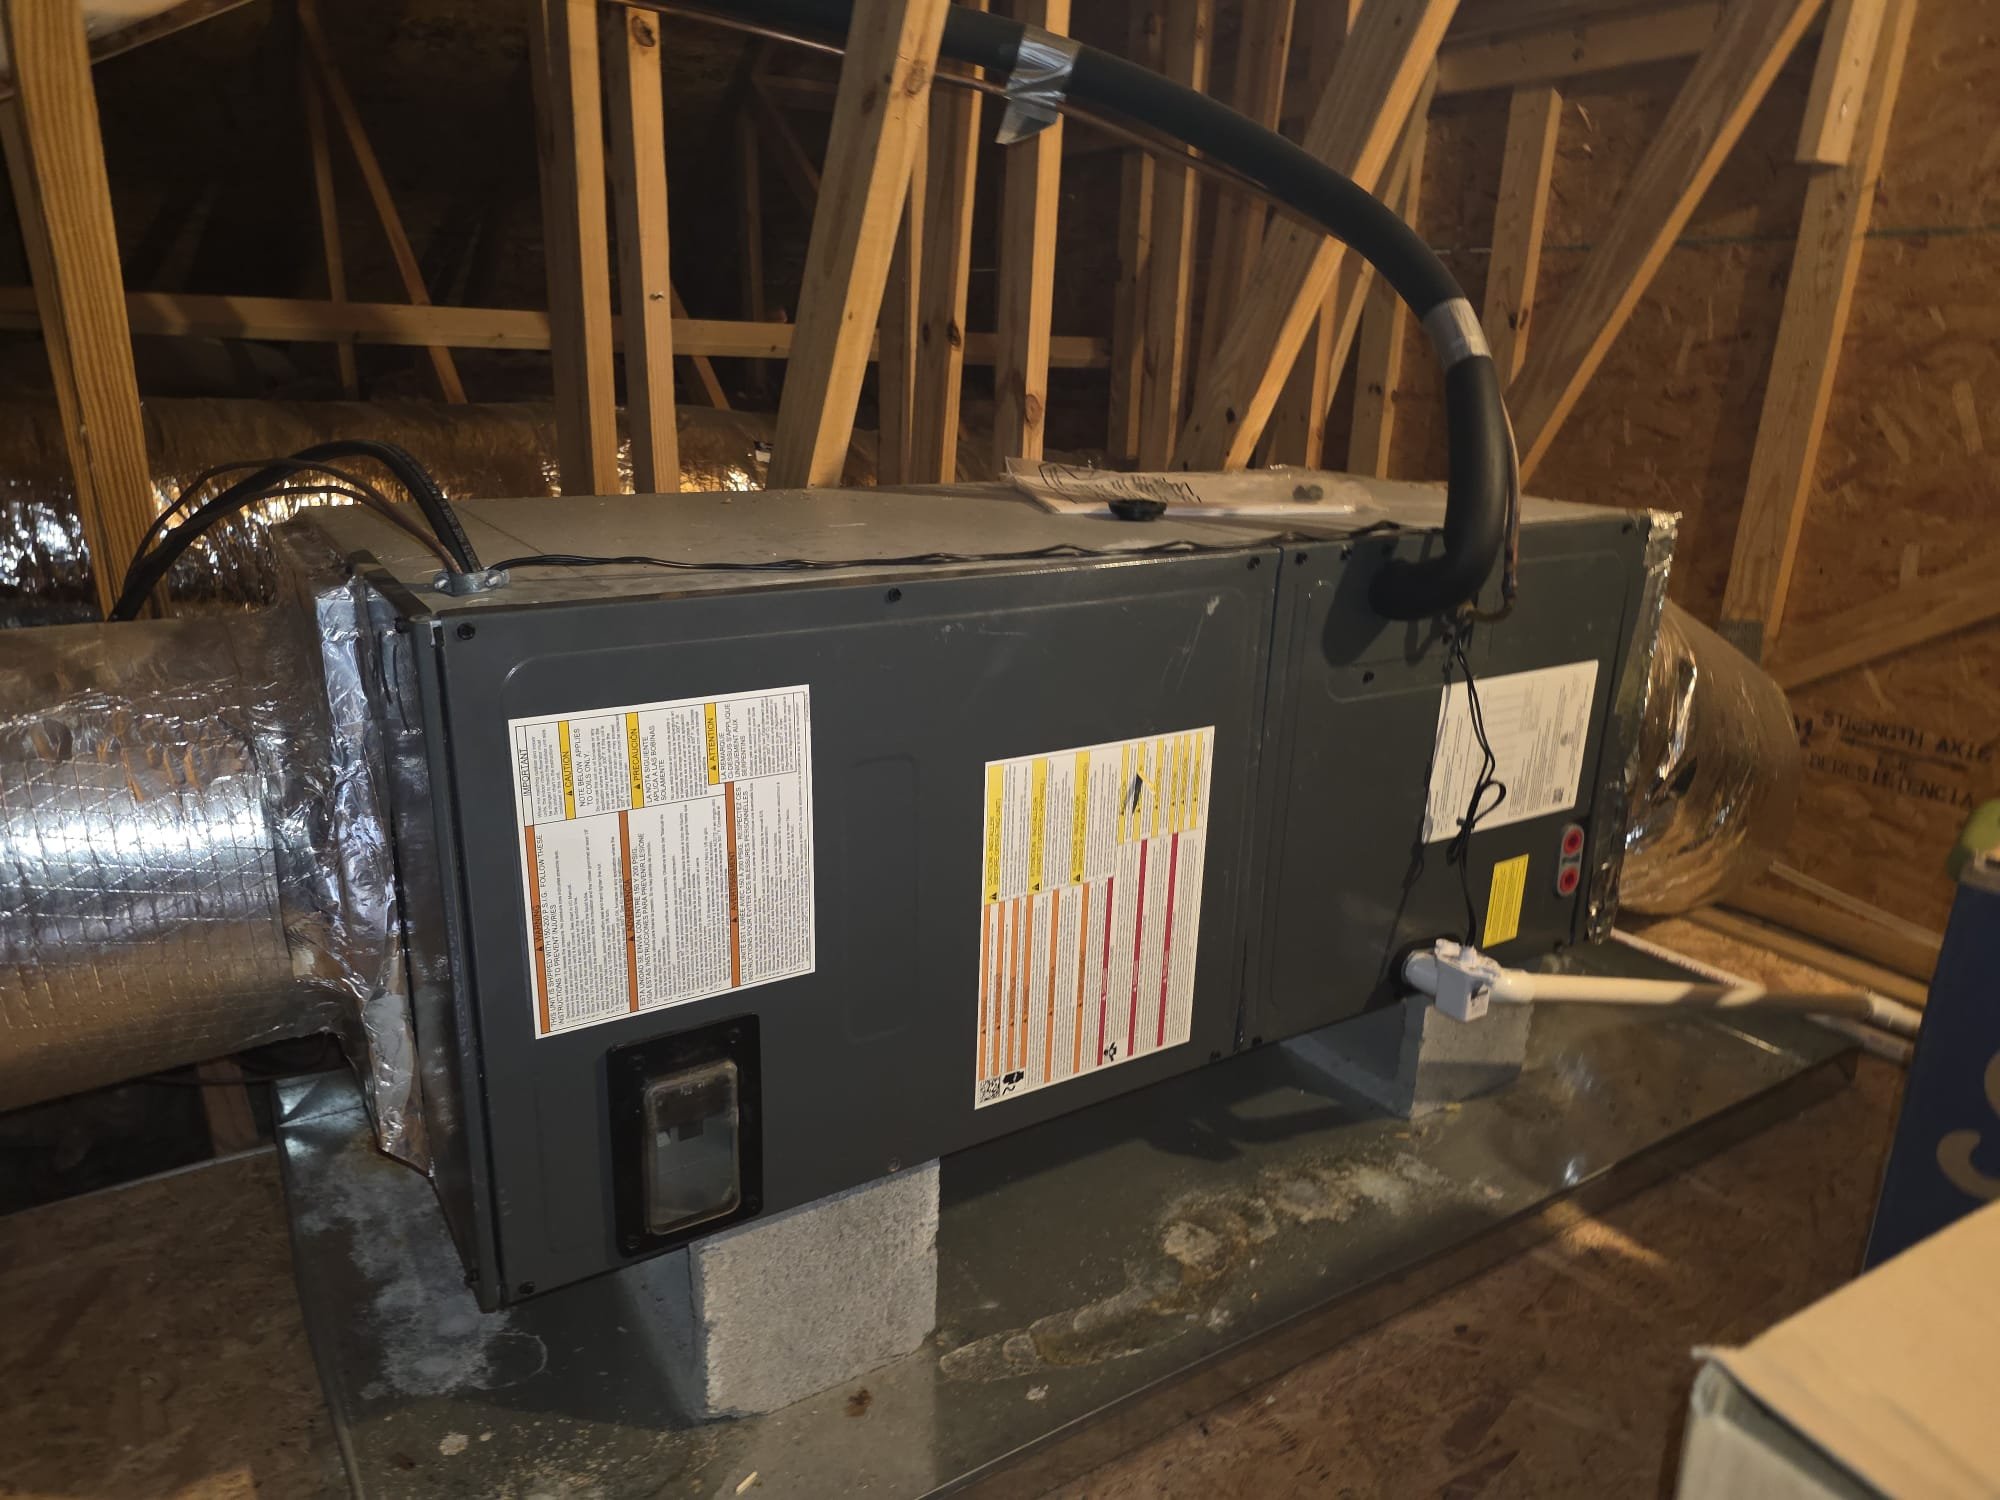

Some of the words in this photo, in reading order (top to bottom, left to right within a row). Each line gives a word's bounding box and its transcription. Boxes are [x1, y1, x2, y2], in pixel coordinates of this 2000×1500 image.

[574, 728, 582, 758] APPLIES
[649, 725, 657, 756] BOBINAS
[708, 717, 716, 762] ATTENTION
[1823, 710, 1924, 749] STRENGTH
[563, 751, 572, 788] CAUTION
[642, 736, 651, 773] SIGUIENTE
[520, 748, 531, 797] IMPORTANT
[576, 760, 584, 786] BELOW
[585, 773, 593, 795] COILS
[659, 759, 667, 801] SOLAMENTE
[721, 771, 727, 780] LA
[578, 788, 586, 807] NOTE
[587, 795, 594, 806] TO
[646, 794, 652, 803] LA
[735, 802, 743, 840] RESPECTEZ
[536, 834, 544, 857] THESE
[538, 859, 546, 888] FOLLOW
[743, 843, 751, 880] BLESSURES
[639, 862, 648, 896] PREVENIR
[550, 904, 558, 935] INJURIES
[641, 896, 649, 914] PARA
[552, 936, 561, 967] PREVENT
[643, 915, 652, 967] INSTRUCCIONES
[546, 958, 554, 987] SHIPPED
[555, 967, 561, 977] TO
[637, 955, 644, 964] SE
[556, 977, 565, 1025] INSTRUCTIONS
